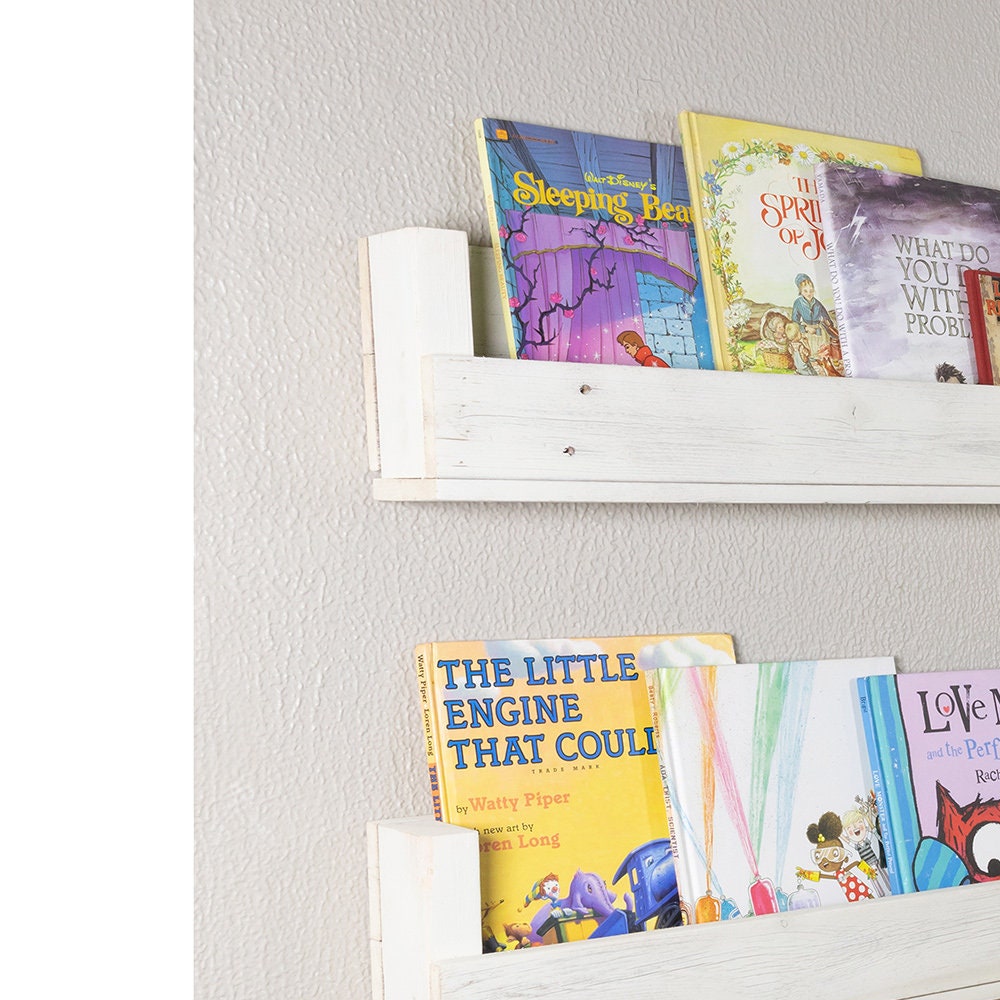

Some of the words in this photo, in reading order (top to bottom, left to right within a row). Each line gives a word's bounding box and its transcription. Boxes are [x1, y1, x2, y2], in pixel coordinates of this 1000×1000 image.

[513, 171, 633, 225] Sleeping
[816, 174, 824, 203] YAMADA
[778, 226, 804, 246] OF
[494, 242, 502, 272] SLEEPING
[826, 242, 836, 268] WHAT
[892, 234, 955, 260] WHAT
[959, 243, 990, 264] DO
[830, 270, 838, 285] DO
[896, 256, 949, 286] YOU
[833, 287, 842, 304] YOU
[836, 308, 844, 320] DO
[838, 324, 848, 348] WITH
[437, 658, 515, 690] THE
[524, 653, 639, 686] LITTLE
[443, 694, 583, 730] ENGINE
[447, 734, 545, 770] THAT
[927, 747, 944, 760] and
[945, 740, 963, 758] the
[429, 766, 438, 791] THE
[532, 767, 565, 775] TRADE
[456, 803, 468, 815] by
[469, 794, 518, 812] Watty
[524, 792, 570, 808] Piper
[872, 770, 880, 786] LOVE
[878, 791, 886, 824] MONSTER
[660, 764, 668, 780] ADA
[668, 816, 679, 859] SCIENTIST
[484, 825, 504, 835] new
[506, 824, 520, 833] art
[522, 822, 534, 832] by
[518, 831, 561, 849] Long
